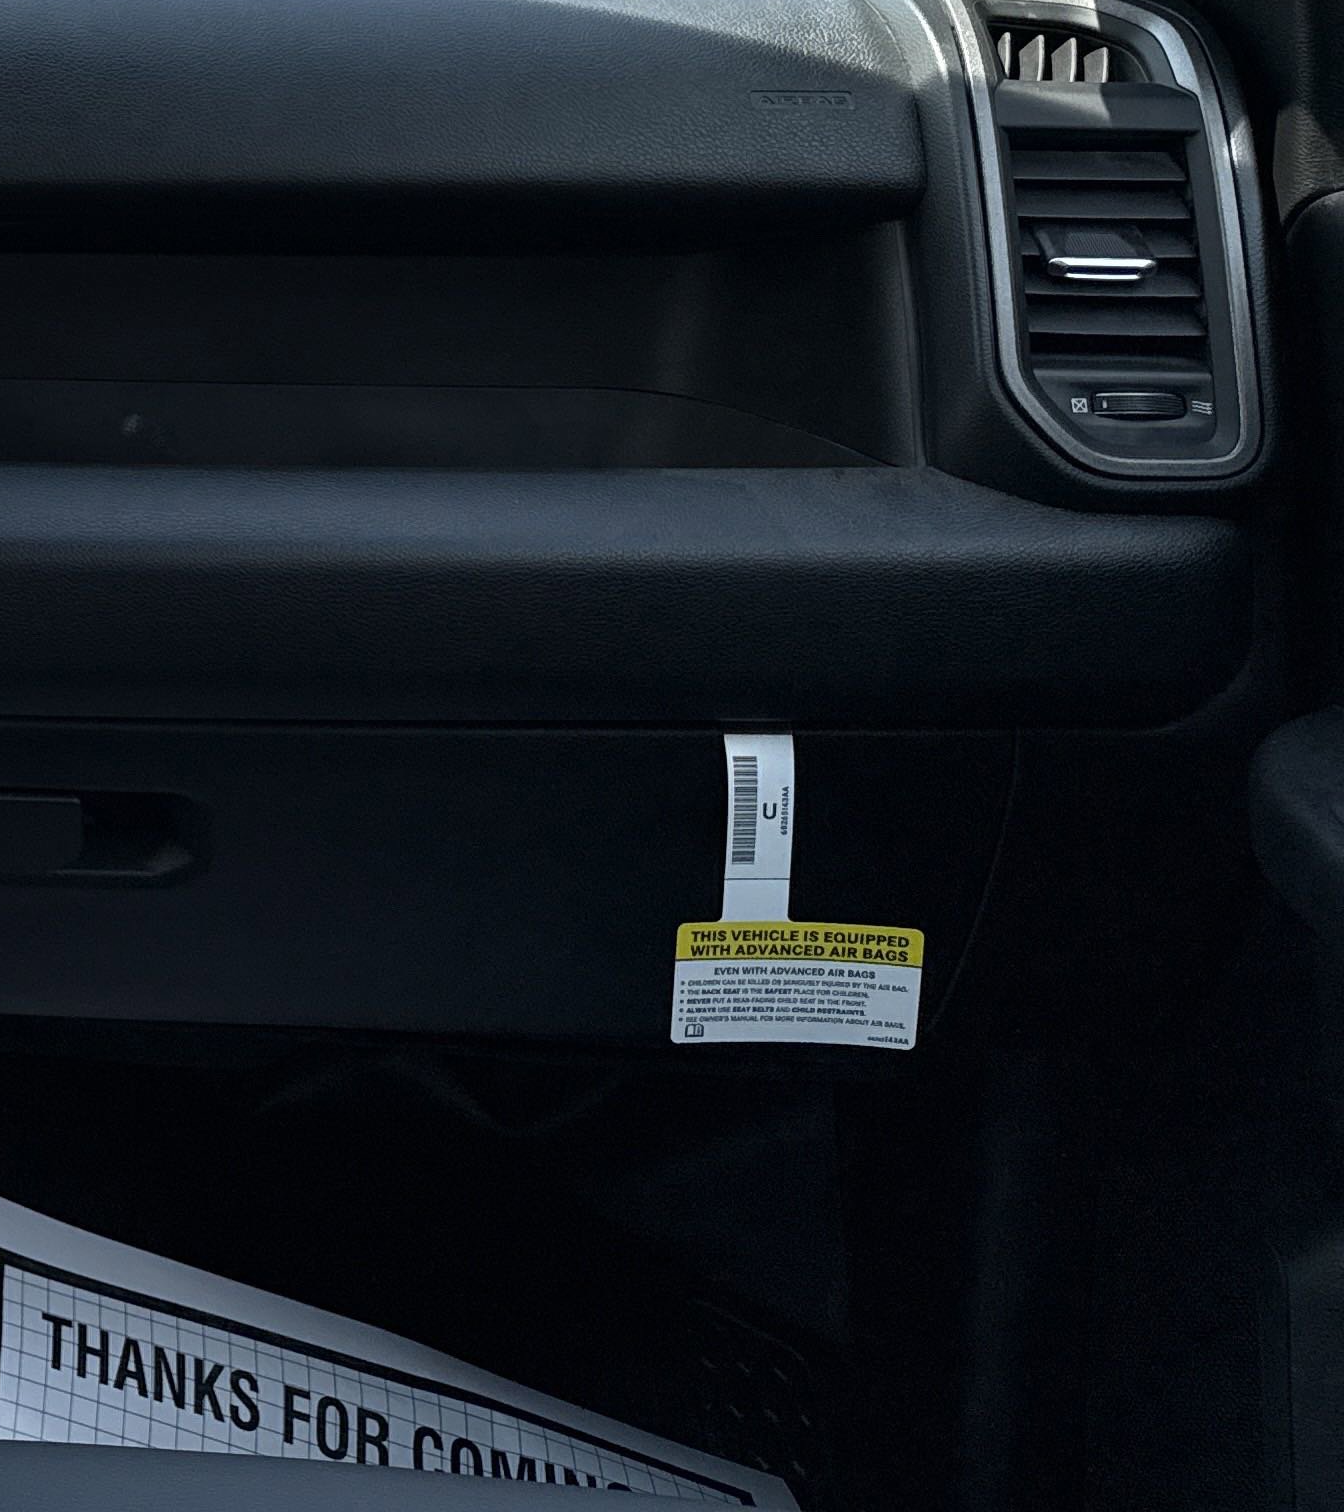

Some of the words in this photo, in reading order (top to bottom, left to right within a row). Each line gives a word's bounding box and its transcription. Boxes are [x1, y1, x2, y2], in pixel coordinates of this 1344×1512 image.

[763, 802, 777, 819] U
[690, 930, 729, 942] THIS
[731, 930, 799, 942] VEHICLE
[803, 931, 818, 942] IS
[823, 932, 910, 948] EQUIPPED
[690, 944, 732, 957] WITH
[735, 944, 826, 957] ADVANCED
[828, 947, 858, 959] AIR
[861, 948, 909, 963] BAGS
[714, 967, 740, 976] EVEN
[742, 967, 768, 976] WITH
[769, 967, 826, 978] ADVANCED
[828, 969, 845, 978] AIR
[847, 970, 876, 979] BAGS
[42, 1312, 260, 1434] THANKS
[283, 1384, 389, 1466] FOR
